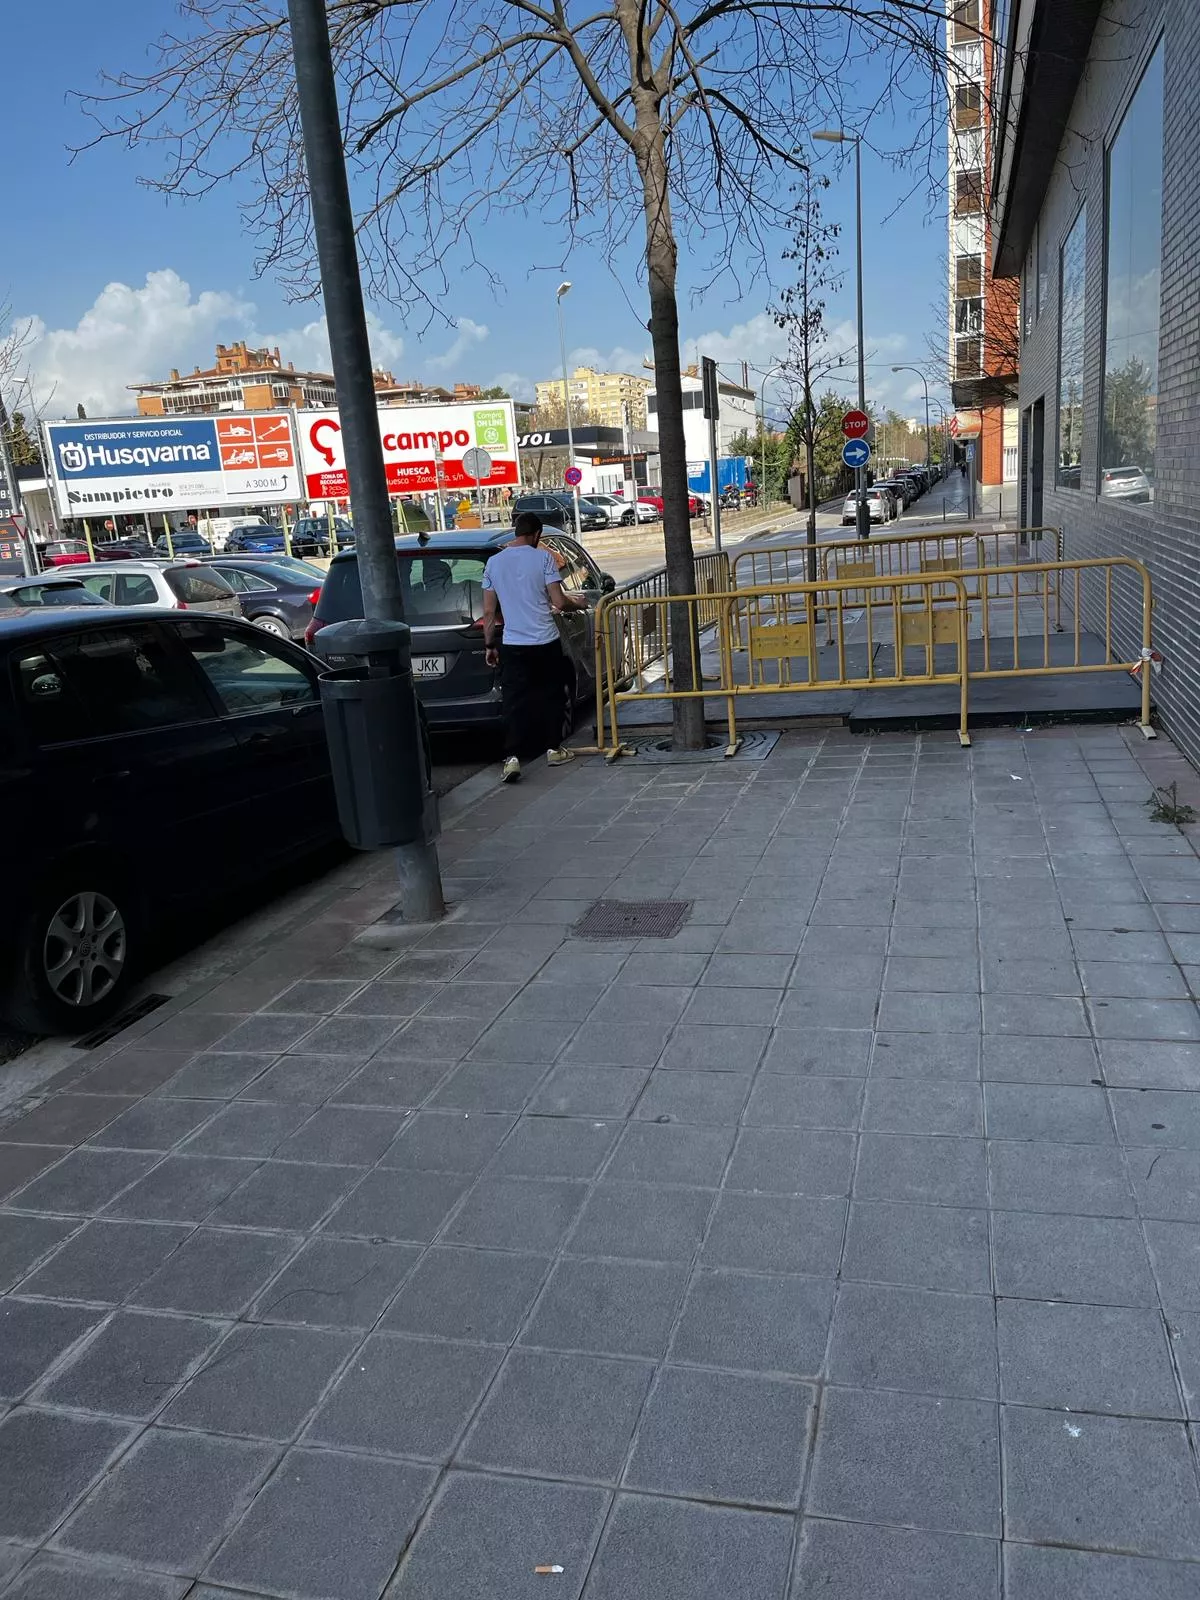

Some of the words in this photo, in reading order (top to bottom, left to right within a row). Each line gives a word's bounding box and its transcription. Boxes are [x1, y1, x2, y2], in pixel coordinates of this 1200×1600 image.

[477, 419, 488, 427] ON
[488, 418, 504, 427] LINE
[844, 420, 867, 430] STOP
[84, 431, 126, 441] DISTRIBUIDOR
[132, 430, 160, 439] SERVICIO
[160, 428, 183, 437] OFICIAL
[383, 429, 470, 452] campo
[87, 444, 210, 467] Husqvarna
[396, 467, 430, 476] HUESCA
[452, 472, 464, 481] s/n
[245, 480, 252, 489] A
[253, 479, 269, 488] 300
[269, 478, 278, 487] M
[67, 486, 174, 504] Sampietro
[417, 659, 439, 672] JKK
